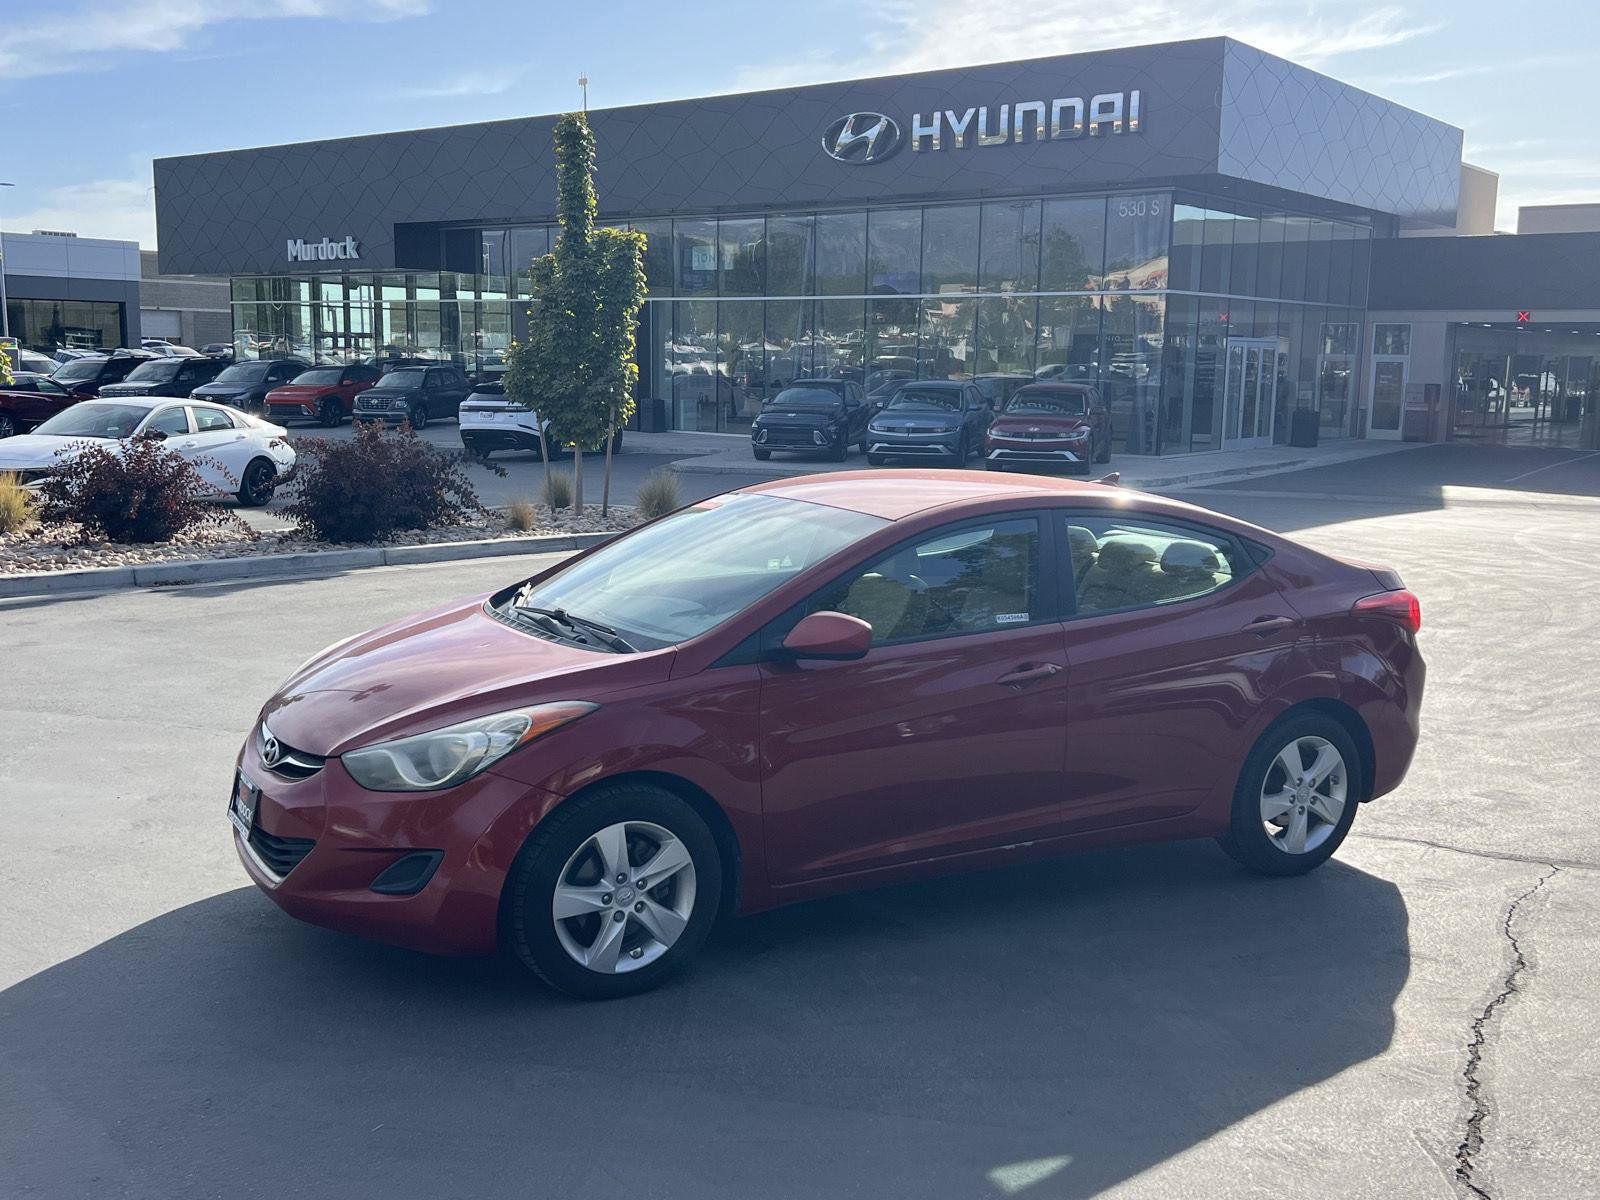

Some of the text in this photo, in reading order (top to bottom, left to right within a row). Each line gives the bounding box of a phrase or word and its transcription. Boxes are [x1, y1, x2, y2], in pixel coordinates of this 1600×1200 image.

[912, 89, 1140, 151] HYUNDAI
[1119, 199, 1160, 217] 530 S
[287, 235, 359, 262] Murdock
